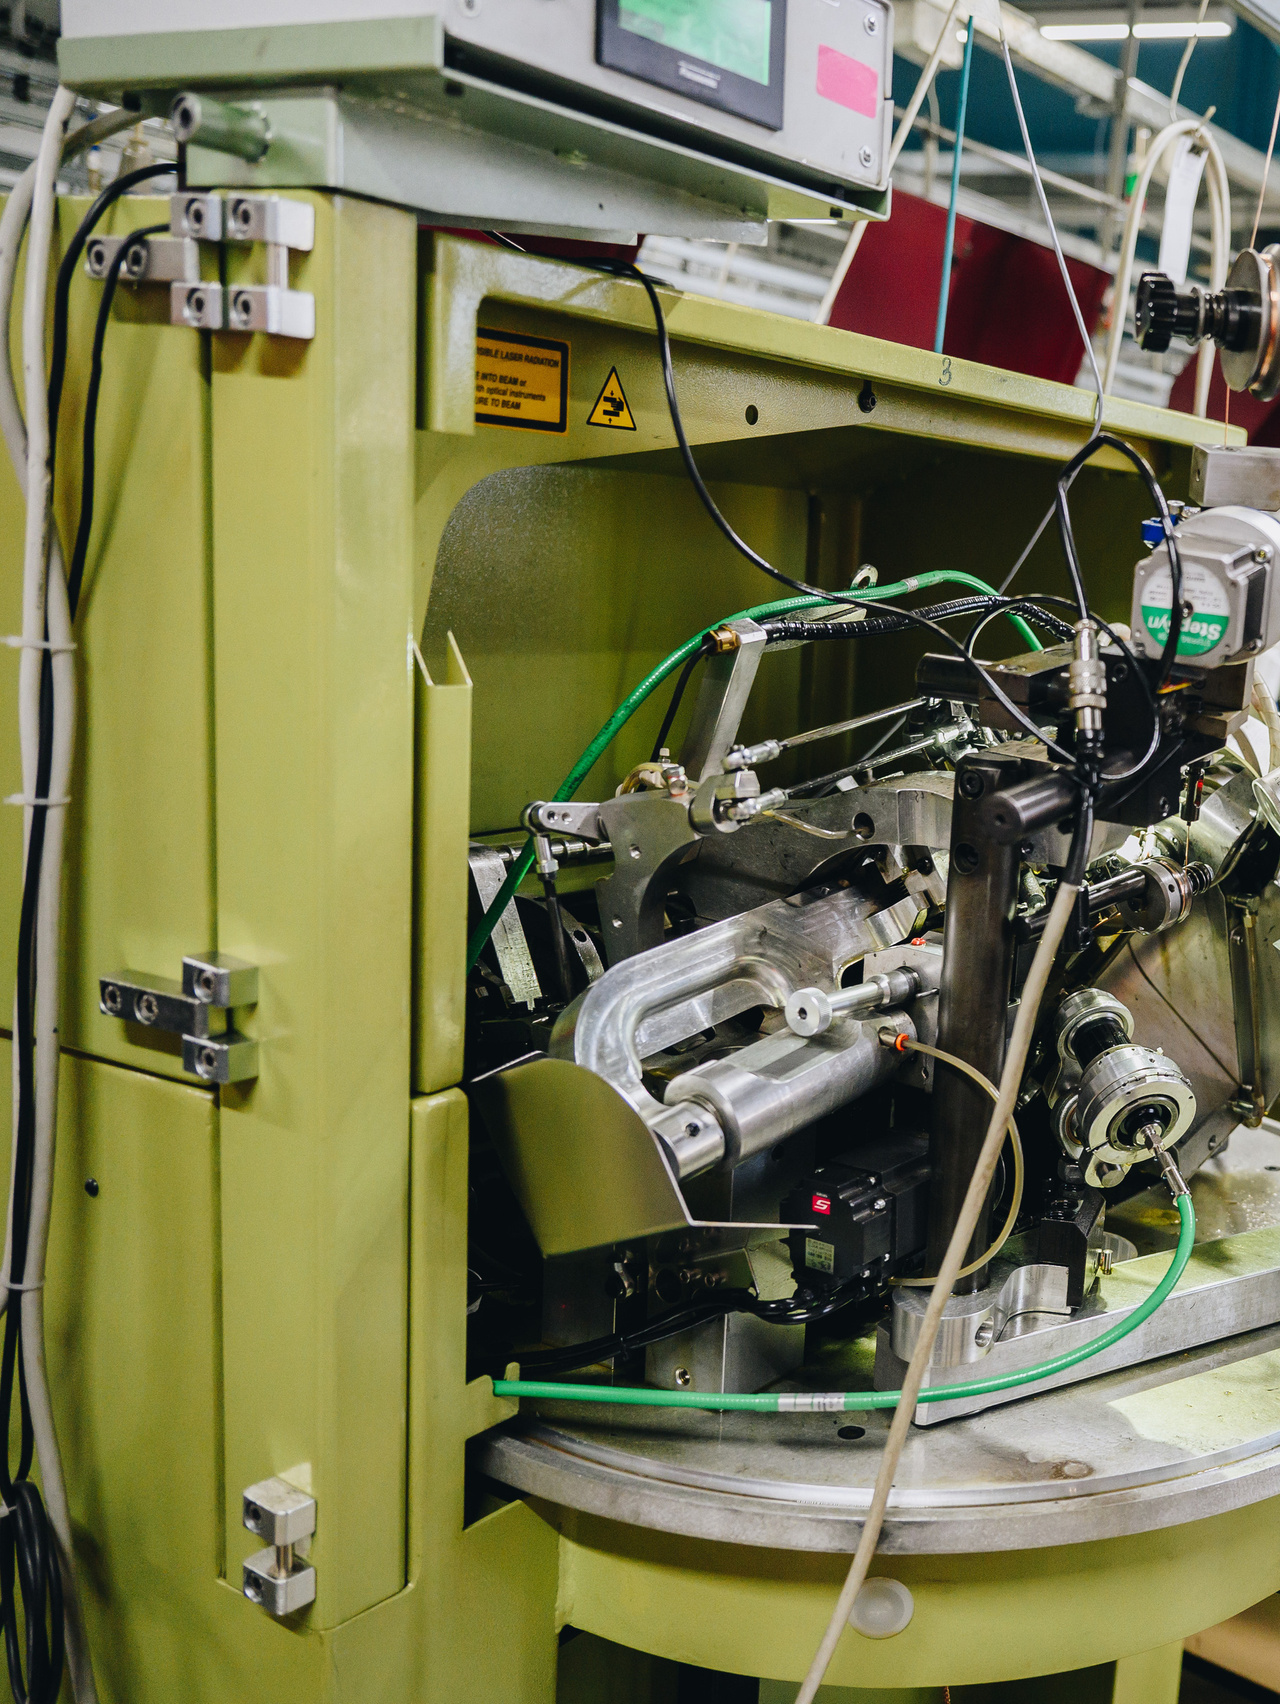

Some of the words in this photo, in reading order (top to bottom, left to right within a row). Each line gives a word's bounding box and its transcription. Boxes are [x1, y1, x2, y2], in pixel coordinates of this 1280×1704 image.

[501, 350, 523, 361] LASER
[524, 355, 559, 367] RADIATION
[481, 372, 498, 383] INTO
[499, 374, 519, 385] BEAM
[939, 357, 952, 386] 3
[491, 398, 500, 408] TO
[501, 399, 521, 411] BEAM
[1148, 614, 1222, 640] Stepyn
